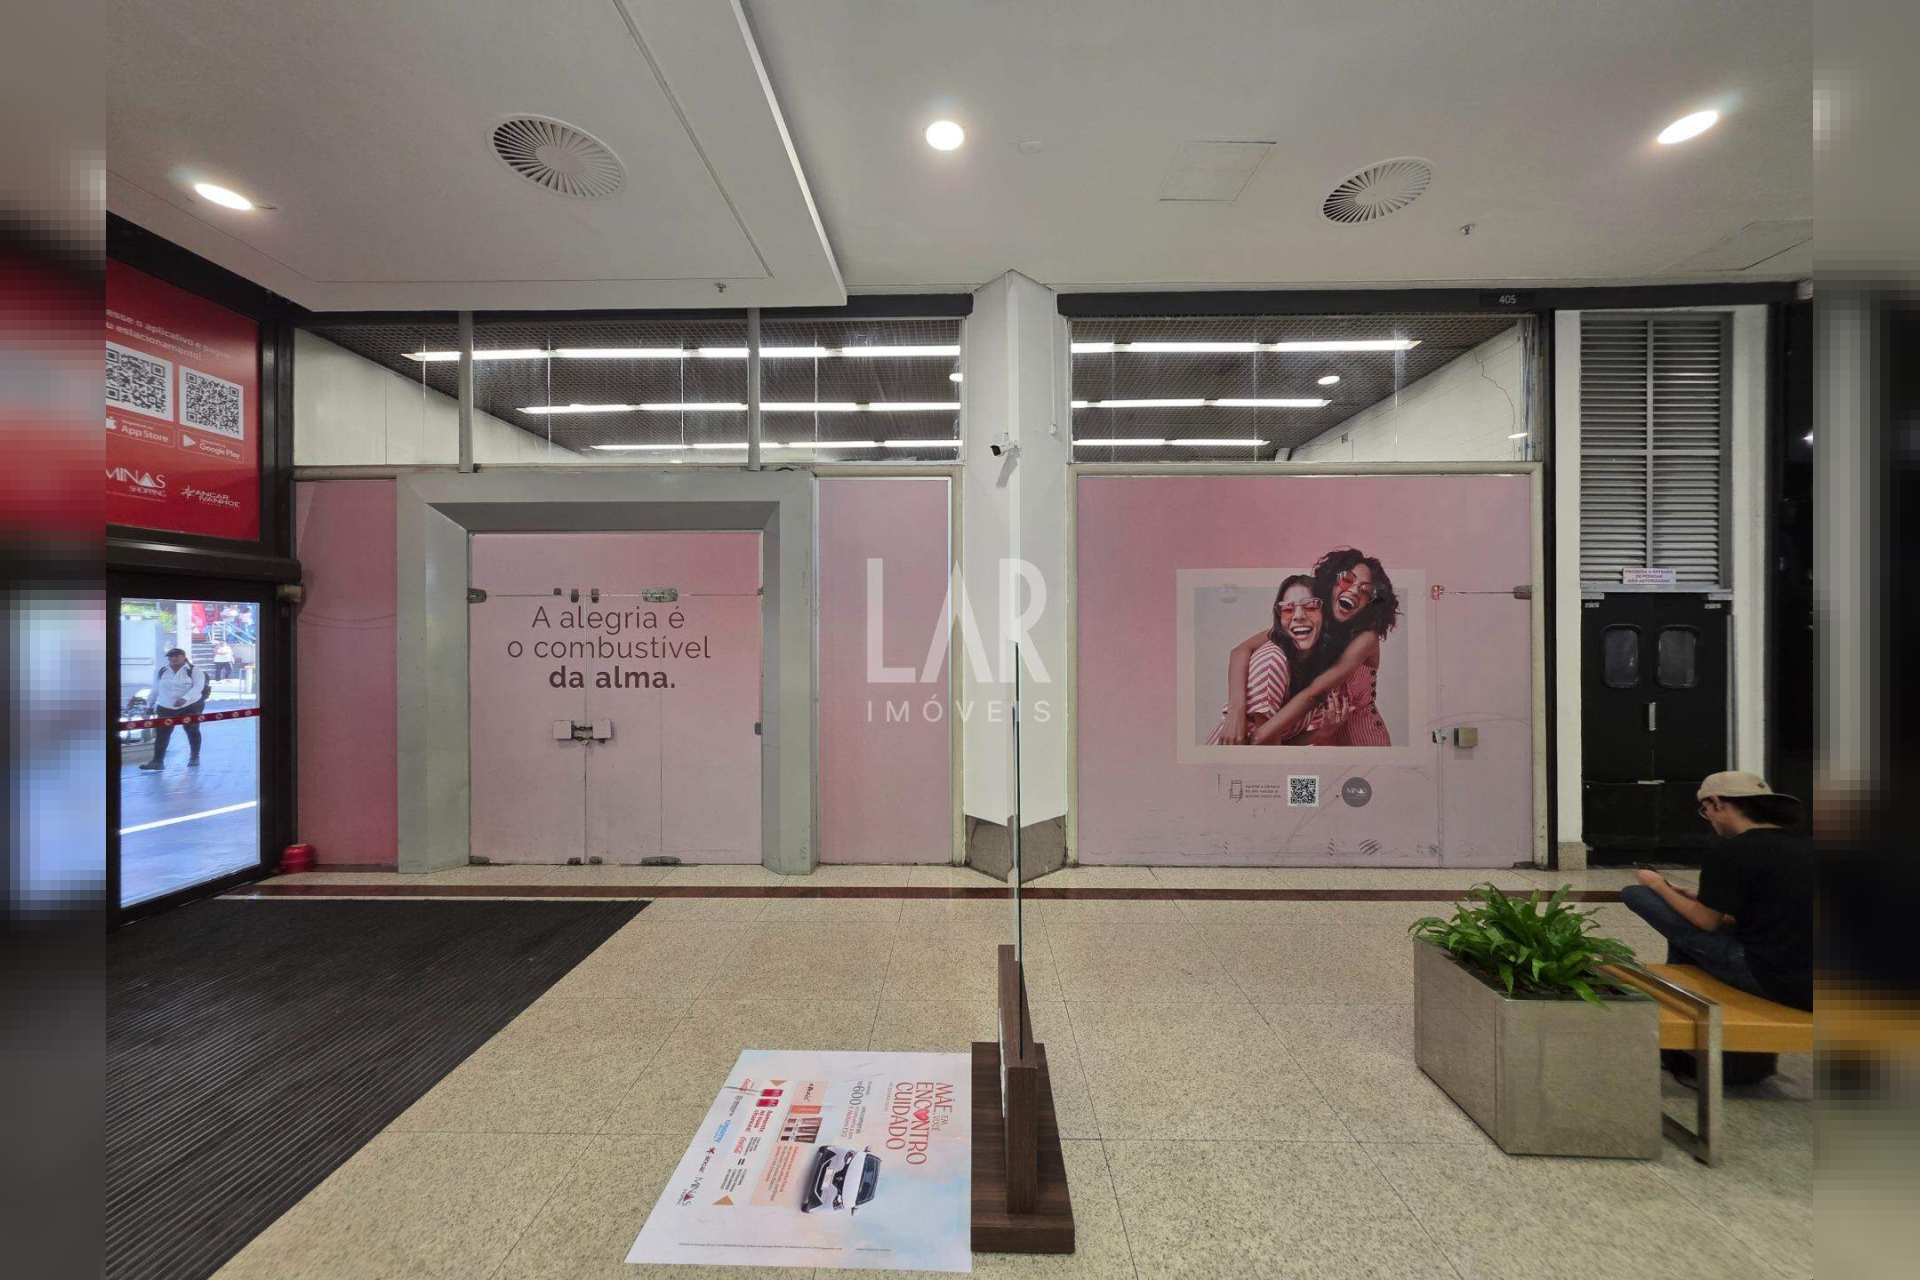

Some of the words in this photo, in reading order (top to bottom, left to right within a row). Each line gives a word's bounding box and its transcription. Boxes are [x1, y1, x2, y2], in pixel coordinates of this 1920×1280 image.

[1499, 295, 1516, 304] 405
[145, 324, 194, 346] aplicativo
[121, 425, 142, 437] App
[143, 430, 169, 442] Store
[200, 443, 225, 455] Google
[226, 450, 240, 460] Play
[106, 467, 166, 489] MINAS
[129, 485, 166, 497] SHOPPING
[196, 490, 229, 499] ANCAR
[199, 496, 240, 508] IVANHOE
[532, 606, 551, 628] A
[560, 606, 658, 635] alegria
[669, 606, 685, 629] é
[508, 641, 523, 659] o
[534, 636, 711, 659] combustível
[550, 665, 584, 689] da
[595, 665, 676, 689] alma.
[850, 1086, 865, 1106] 600
[886, 1082, 914, 1150] CUIDADO
[681, 1177, 704, 1206] MINAS
